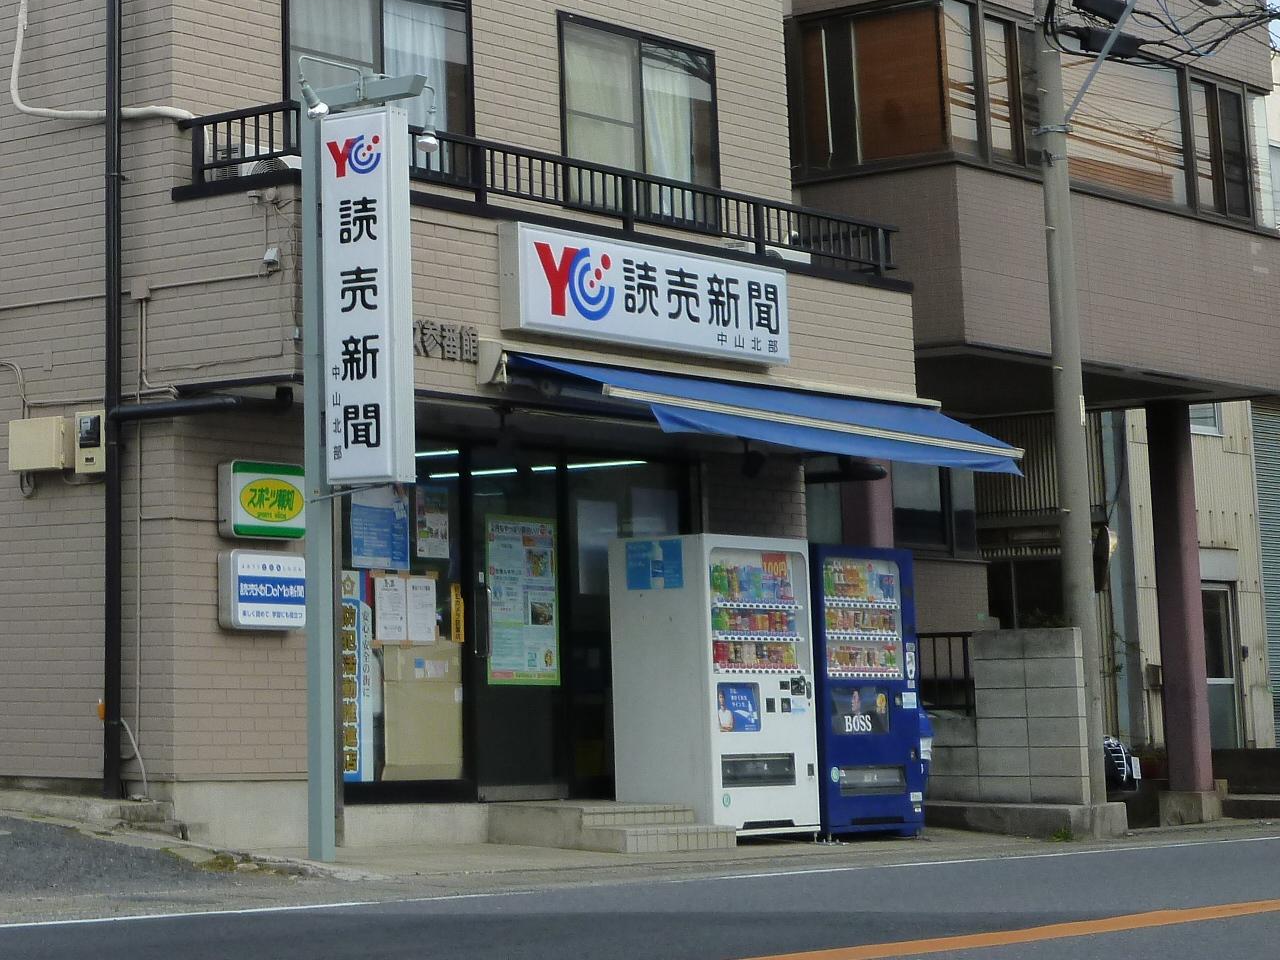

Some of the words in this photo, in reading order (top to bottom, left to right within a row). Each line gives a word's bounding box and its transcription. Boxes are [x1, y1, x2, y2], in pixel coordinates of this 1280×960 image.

[338, 196, 381, 450] 読売新聞
[622, 258, 780, 335] 読売新聞
[717, 332, 779, 354] 中山北部
[331, 364, 342, 460] 中山北部
[844, 714, 872, 733] BOSS
